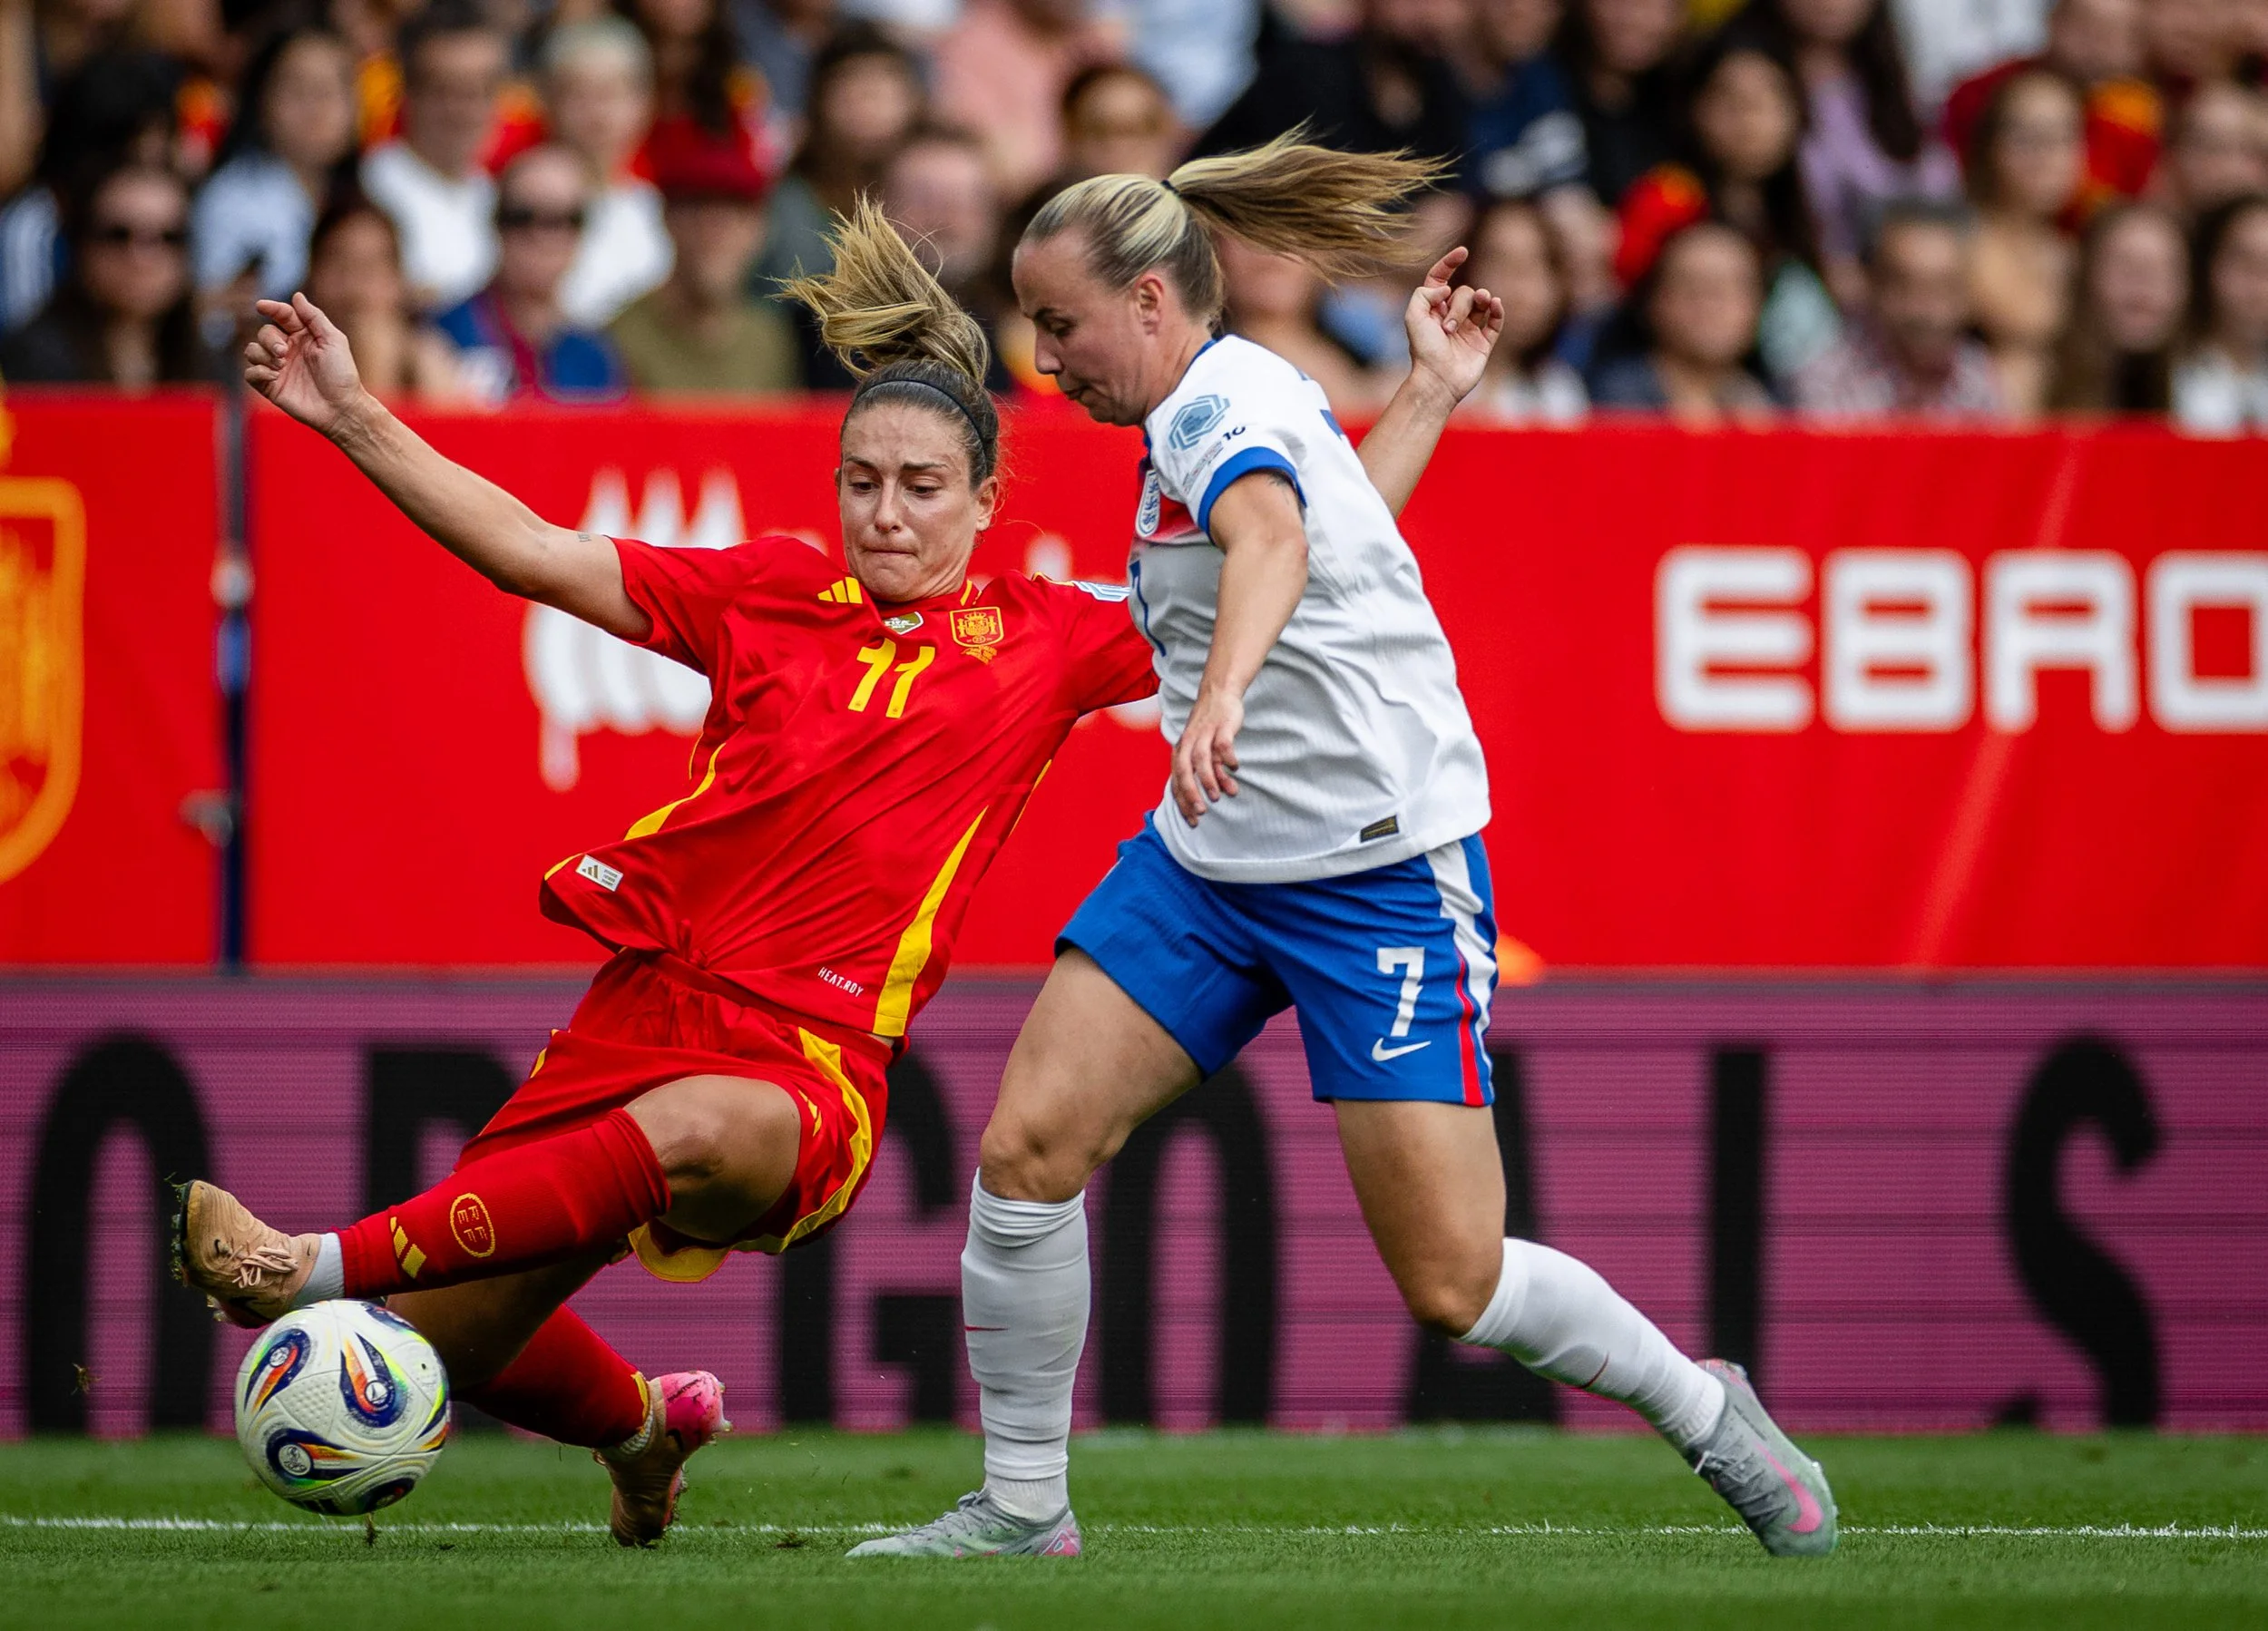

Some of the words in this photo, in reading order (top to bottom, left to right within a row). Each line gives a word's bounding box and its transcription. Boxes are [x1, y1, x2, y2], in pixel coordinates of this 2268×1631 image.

[847, 637, 936, 719] 11
[1655, 545, 2268, 733] EBRO
[1376, 946, 1425, 1038] 7
